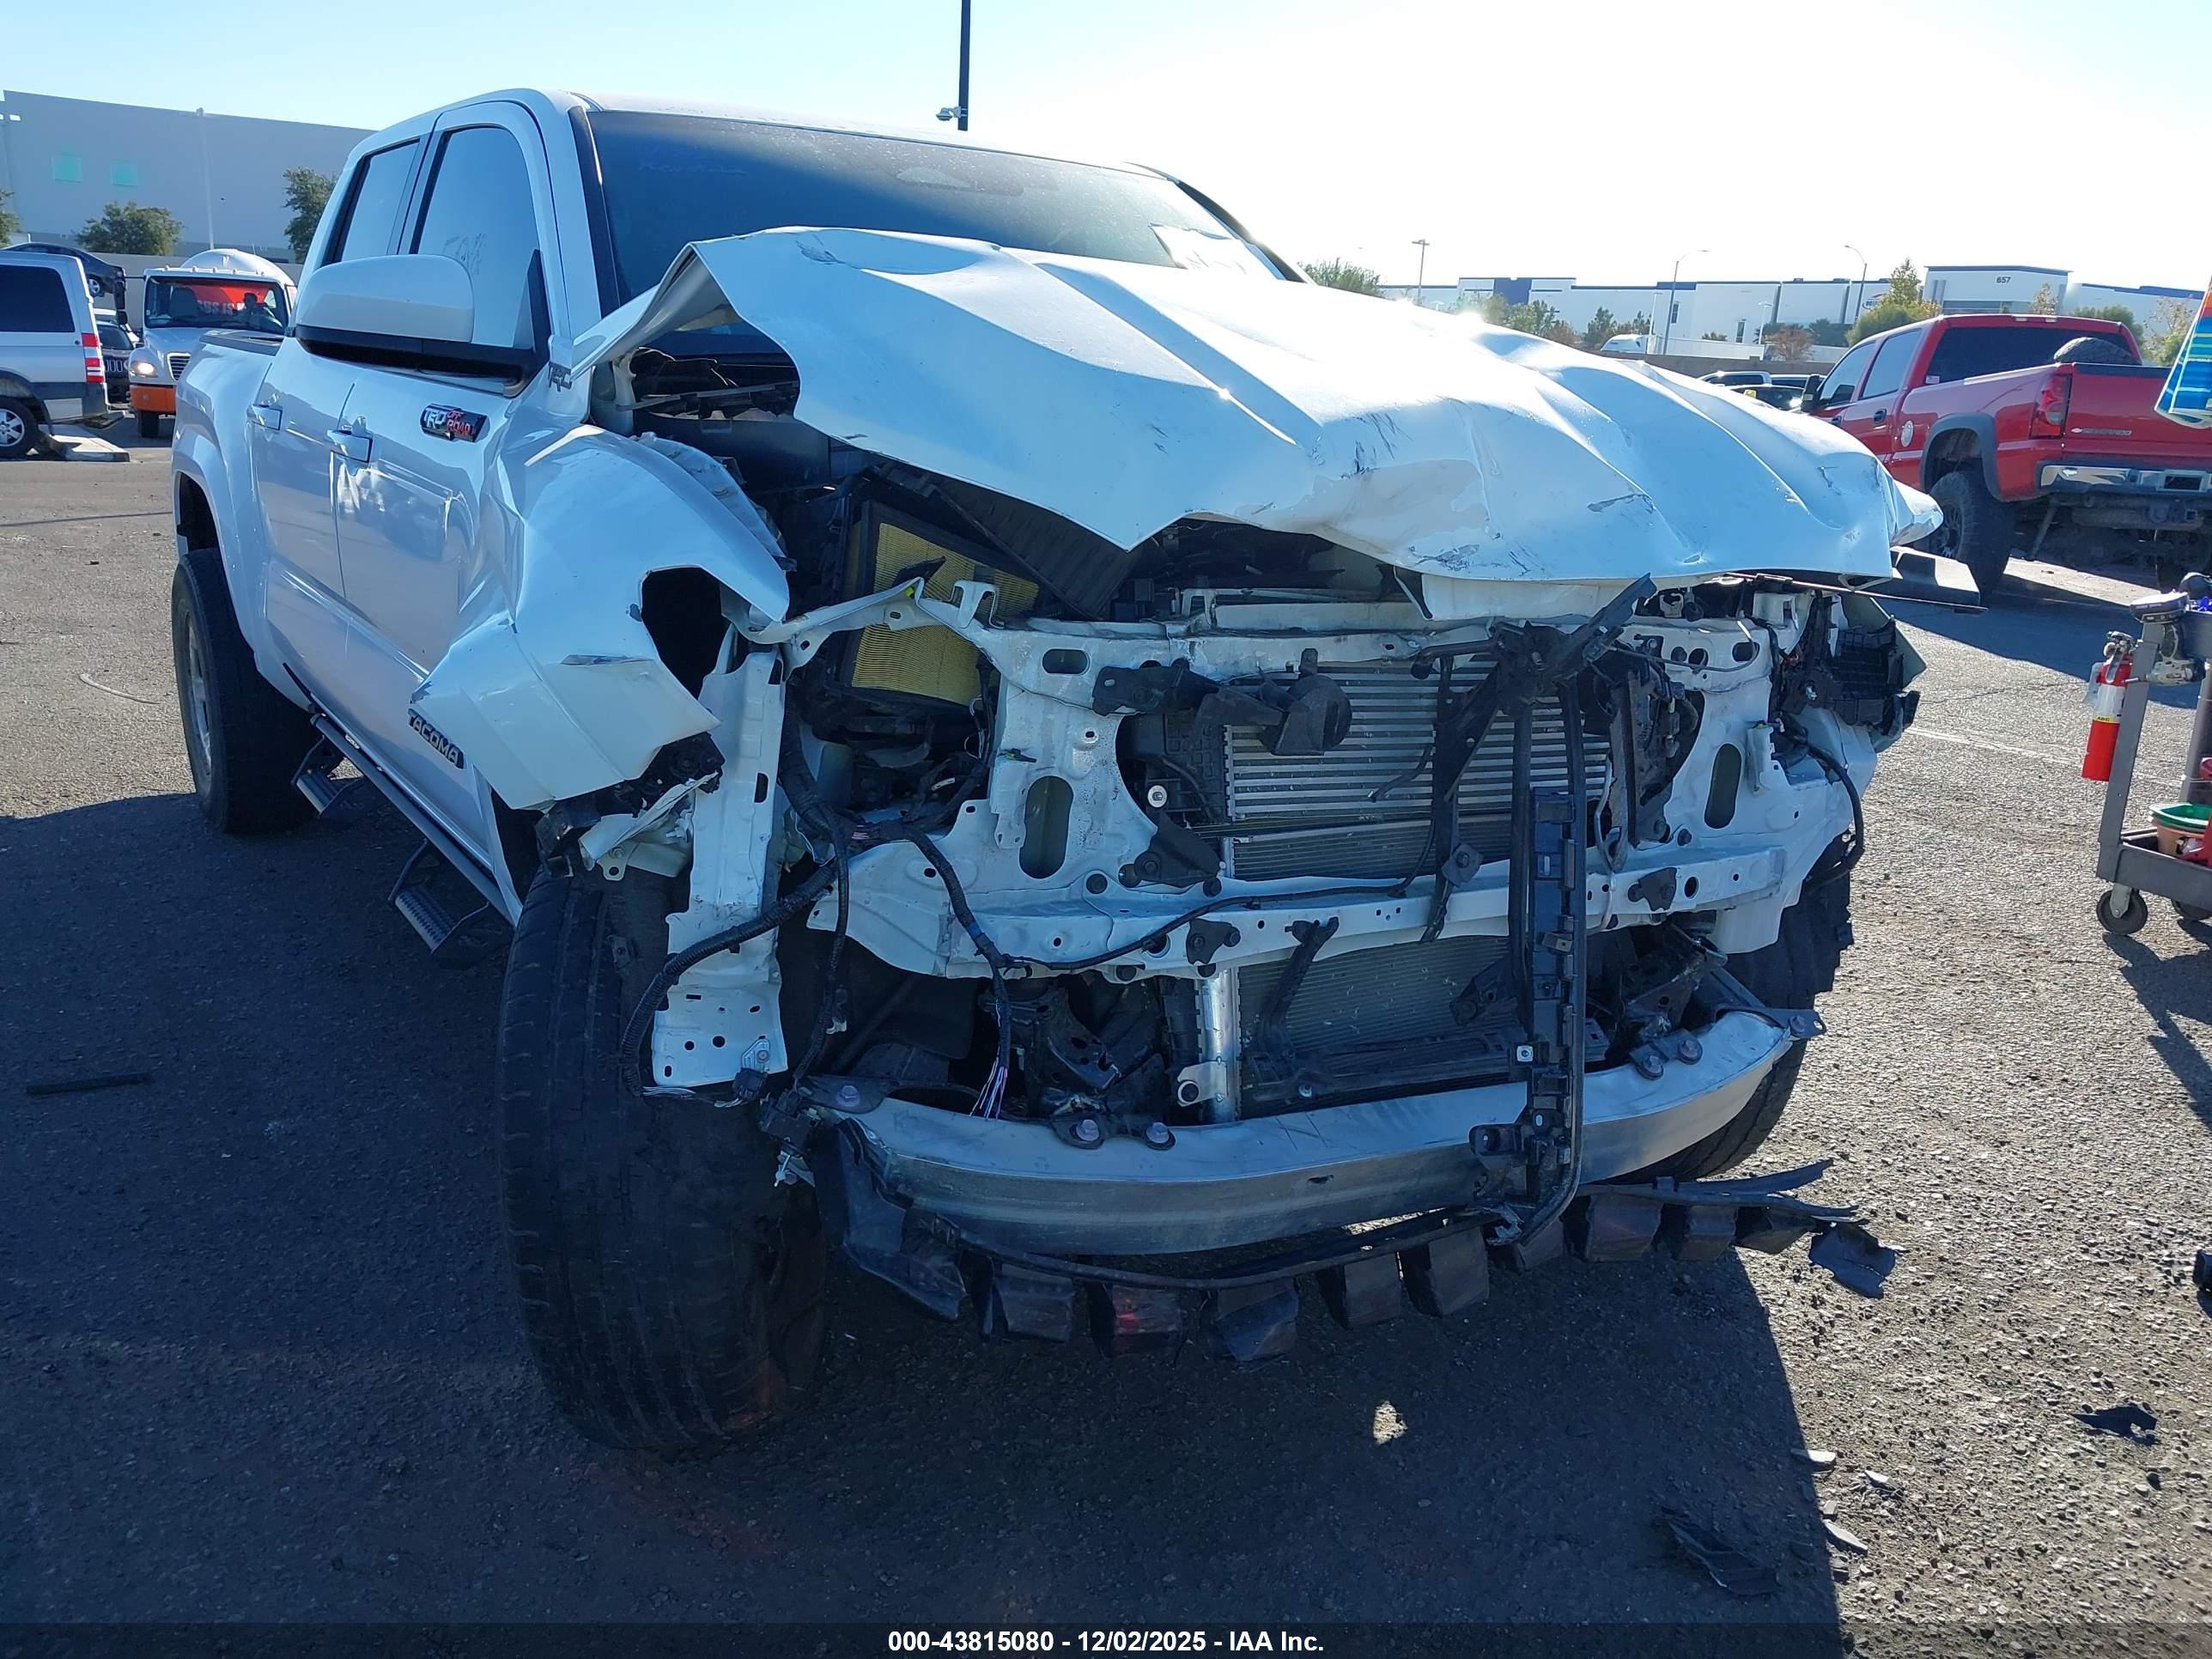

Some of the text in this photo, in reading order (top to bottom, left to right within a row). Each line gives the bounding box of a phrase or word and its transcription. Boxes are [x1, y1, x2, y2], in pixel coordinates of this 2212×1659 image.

[422, 407, 447, 428] TRD
[447, 410, 465, 420] OFF
[407, 709, 461, 766] TACOMA
